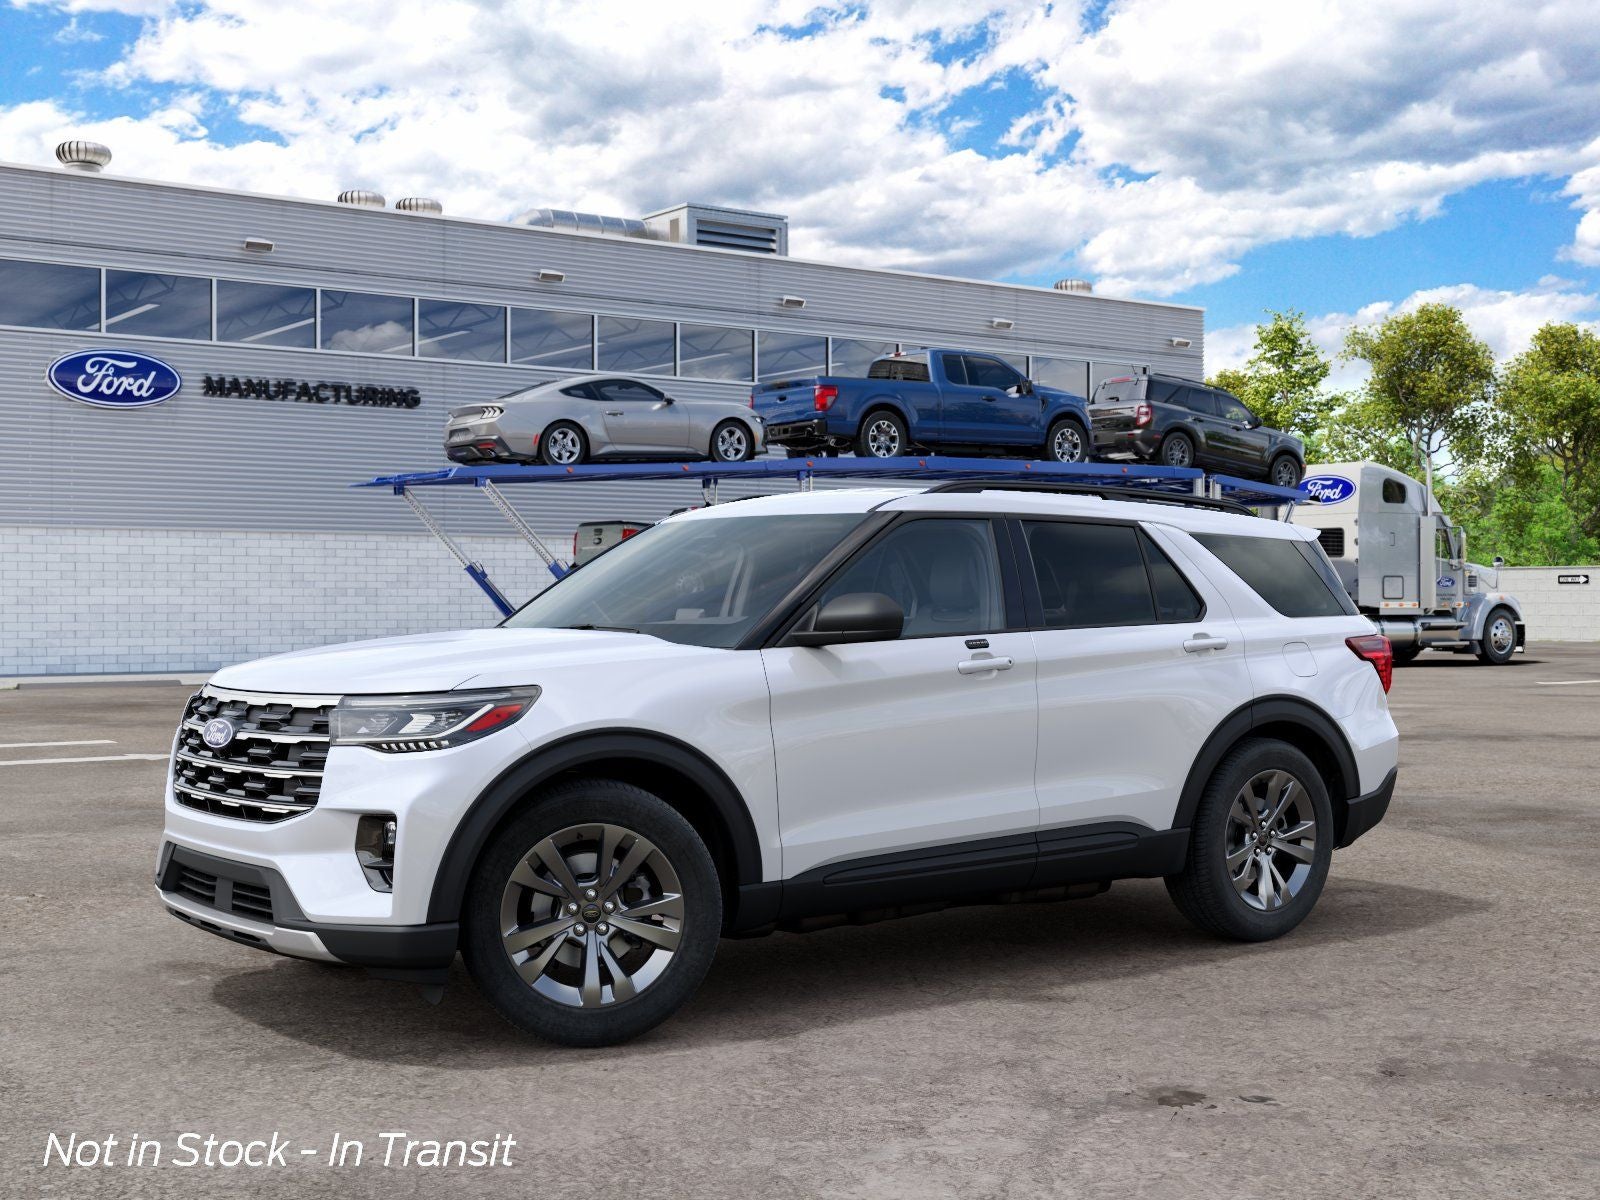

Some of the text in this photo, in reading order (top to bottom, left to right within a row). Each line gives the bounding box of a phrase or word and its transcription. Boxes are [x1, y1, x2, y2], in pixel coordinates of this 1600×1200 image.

[77, 357, 157, 397] Ford
[203, 374, 421, 409] MANUFACTURING
[1306, 480, 1343, 500] Ford
[206, 722, 228, 743] Ford
